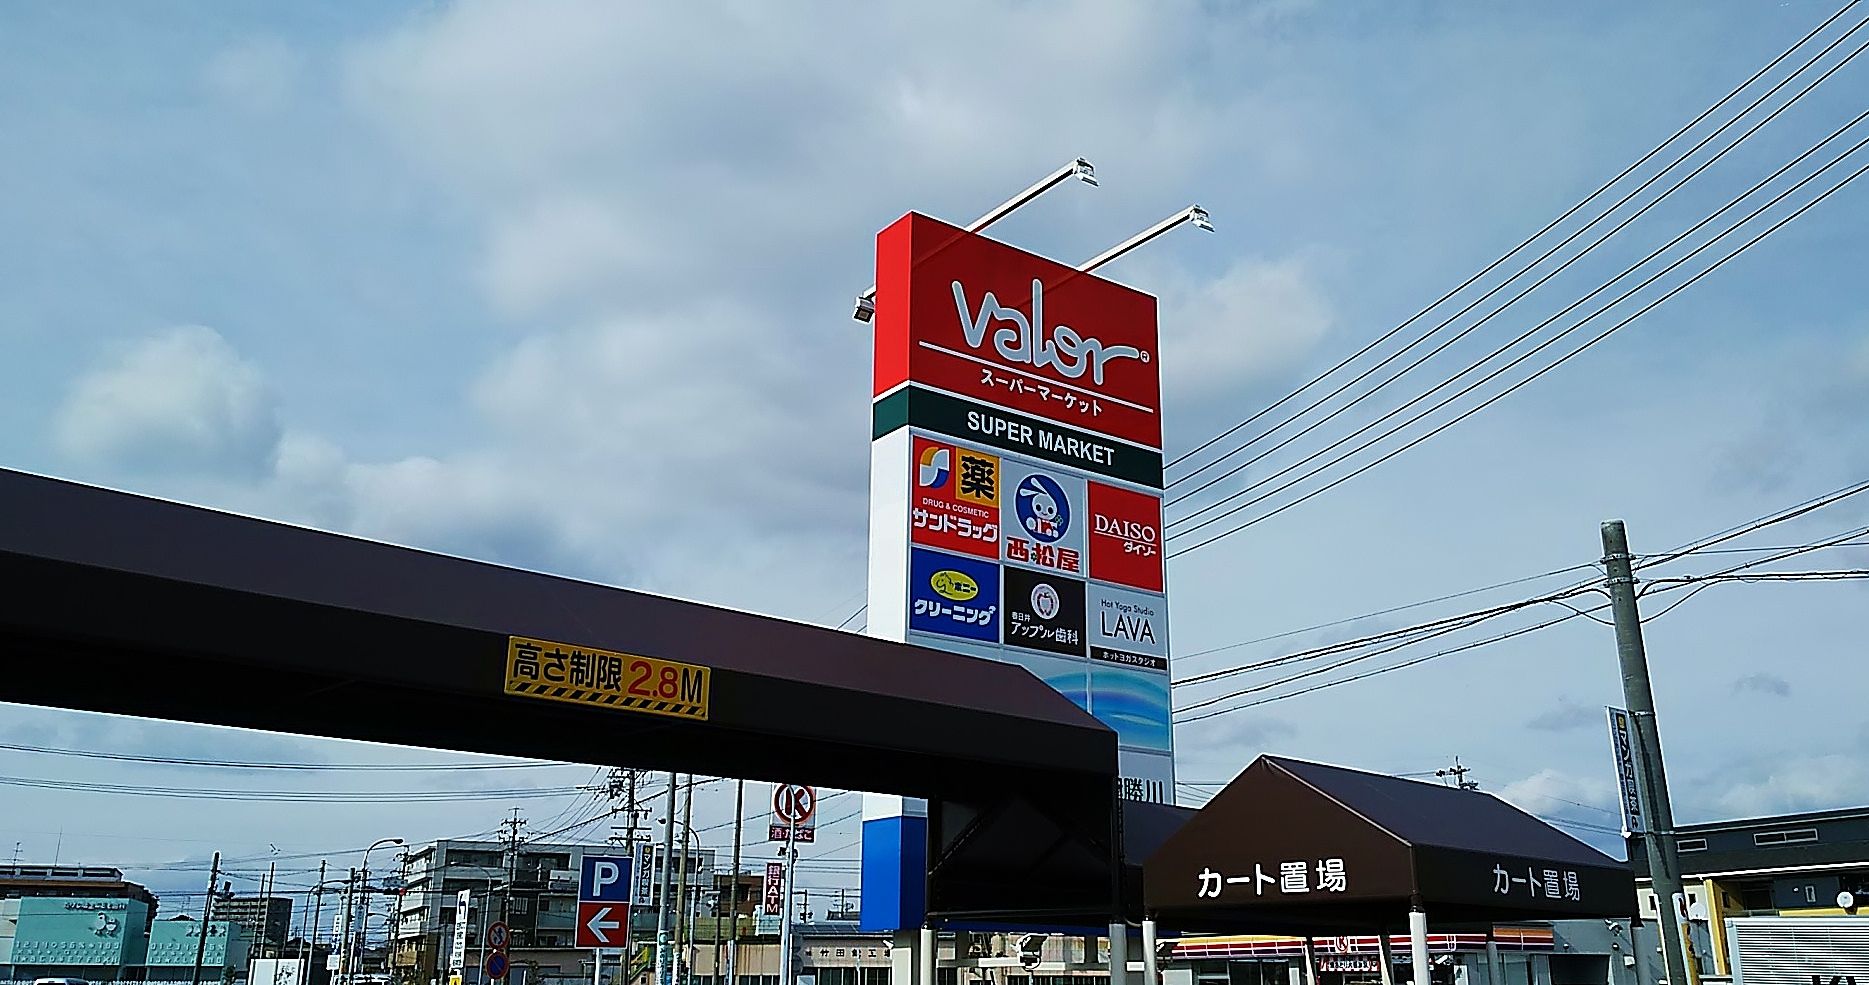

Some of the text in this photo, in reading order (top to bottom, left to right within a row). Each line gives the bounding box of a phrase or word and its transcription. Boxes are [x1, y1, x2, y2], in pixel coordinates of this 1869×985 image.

[980, 368, 1103, 417] スーパーマーケット
[967, 410, 1115, 467] SUPER MARKET
[960, 455, 995, 501] 薬
[912, 507, 998, 543] サンドラッグ
[922, 497, 990, 519] DRUG & COSMETIC
[1094, 513, 1156, 543] DAISO
[1006, 536, 1080, 573] 西松屋
[1123, 541, 1157, 557] ダイソー
[914, 598, 997, 626] クリーニング
[1011, 611, 1031, 622] 春日井
[1101, 599, 1155, 616] Hot Yoga Studio
[1011, 621, 1079, 646] アップル歯科
[1101, 610, 1156, 645] LAVA
[513, 642, 703, 704] 高さ制限 2.8M
[1102, 650, 1157, 667] ホットヨガスタジオ
[1118, 777, 1164, 803] 勝川
[592, 861, 619, 897] P
[766, 865, 781, 914] 銀行ATM
[1198, 858, 1347, 898] カート置場
[1493, 863, 1580, 901] カート置場
